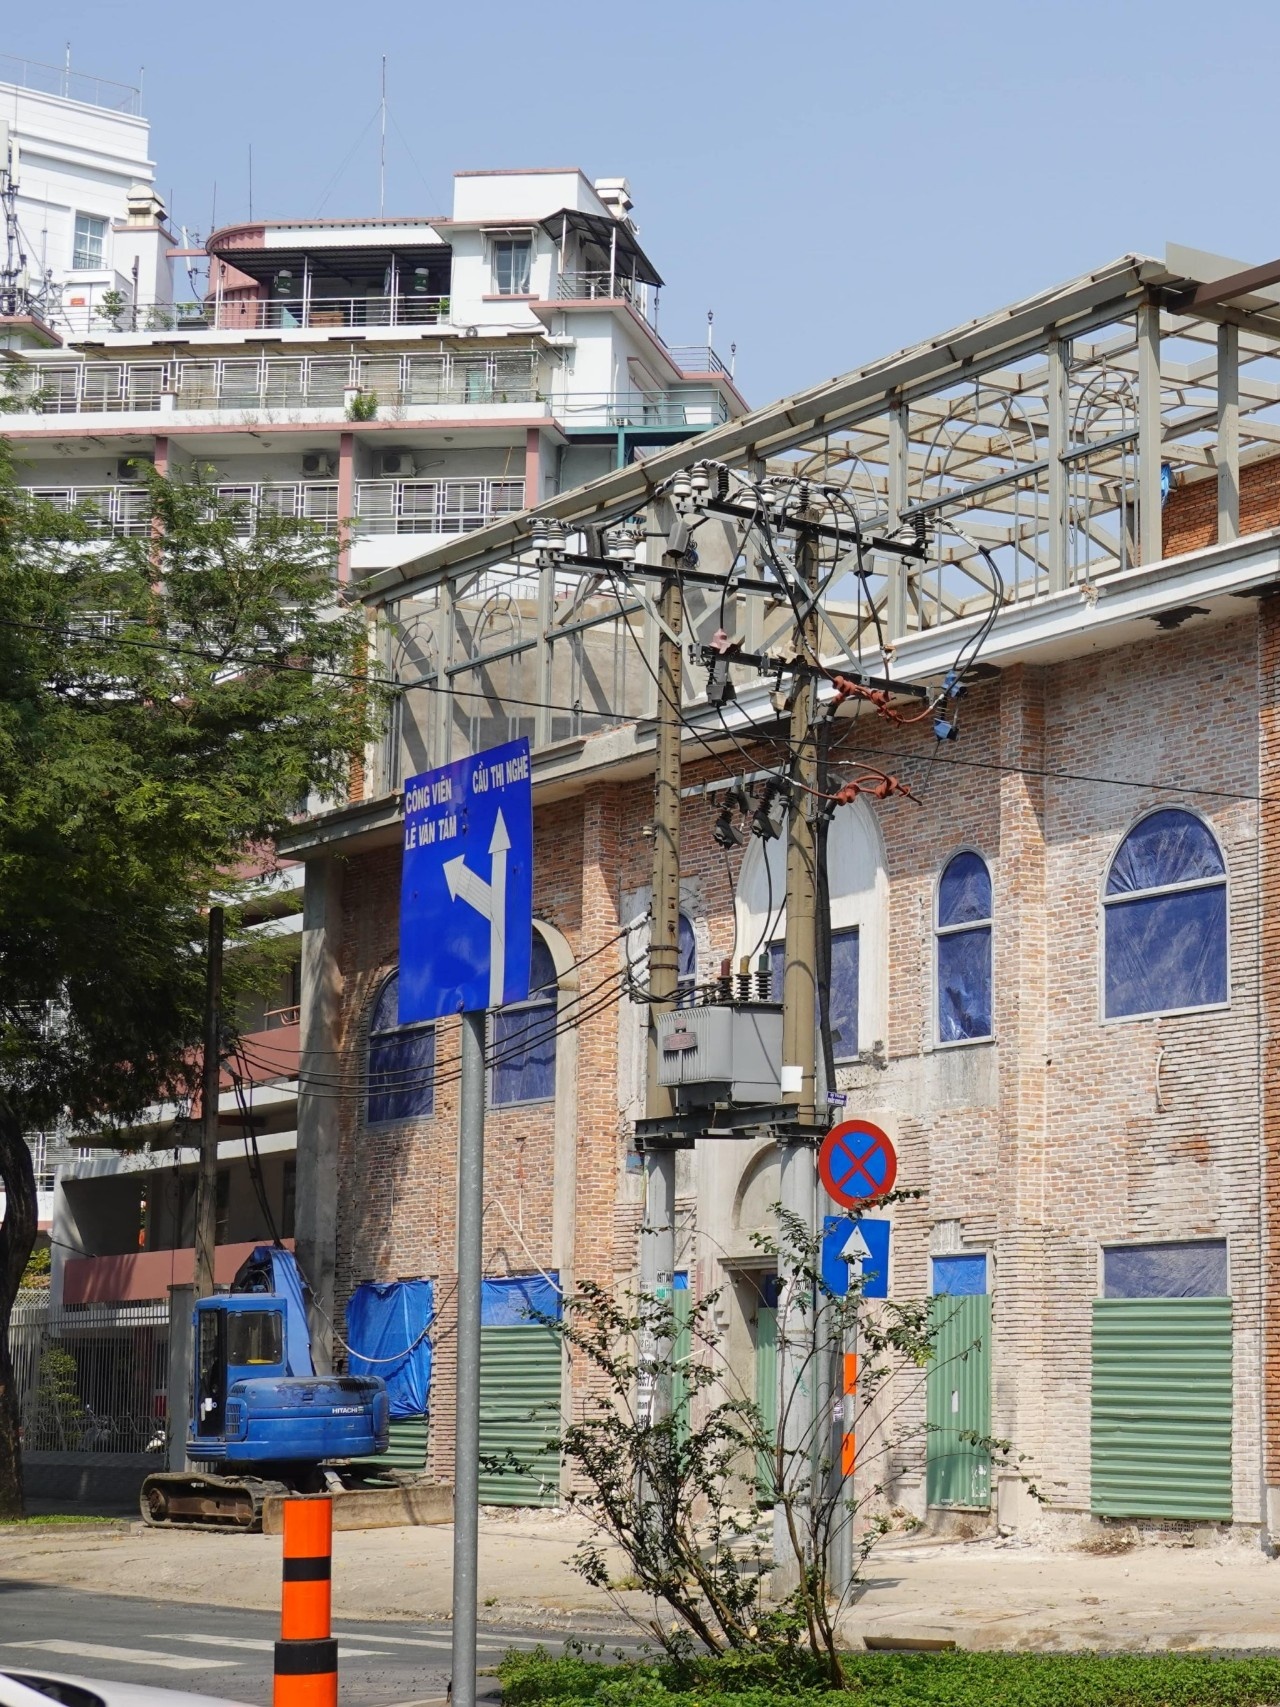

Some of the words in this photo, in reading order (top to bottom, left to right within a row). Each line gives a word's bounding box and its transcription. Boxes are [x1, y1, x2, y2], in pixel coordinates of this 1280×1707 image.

[472, 761, 489, 794] CẦU
[490, 763, 505, 793] THỊ
[506, 749, 529, 784] NGHÈ
[405, 784, 431, 814] CÔNG
[431, 775, 453, 805] VIÊN
[405, 821, 416, 851] LÊ
[418, 817, 436, 847] VĂN
[438, 811, 457, 841] TÁM
